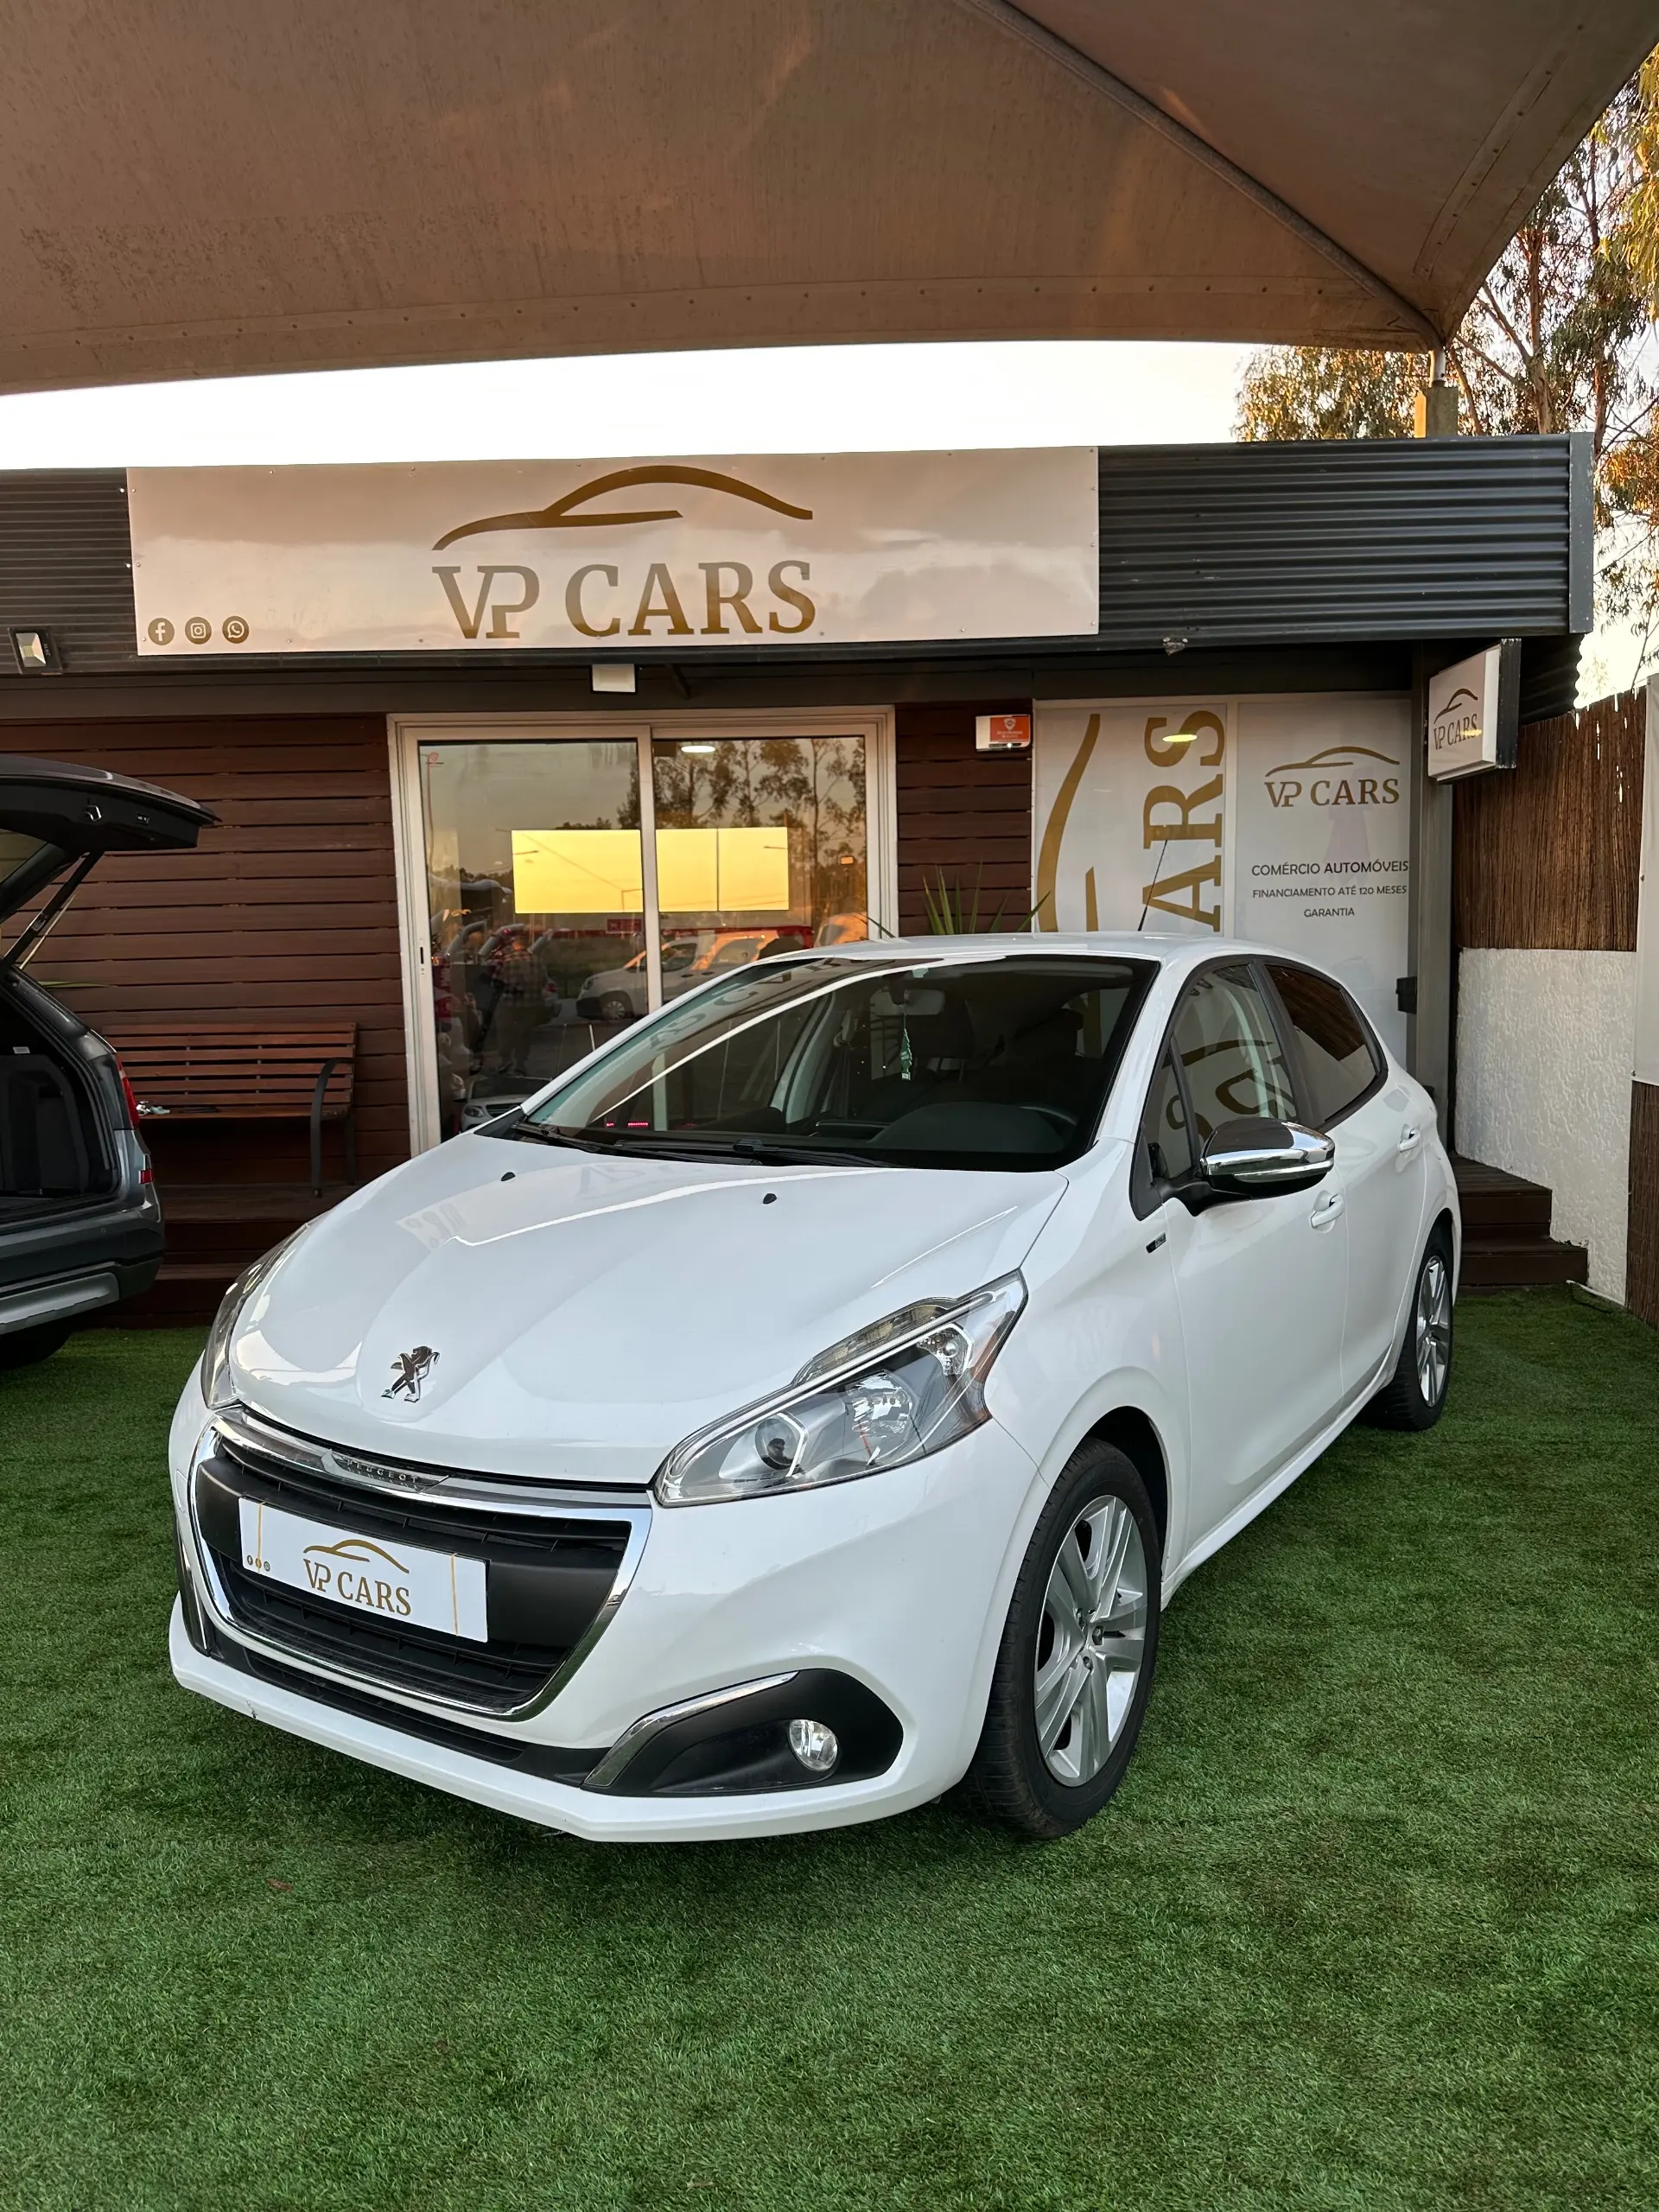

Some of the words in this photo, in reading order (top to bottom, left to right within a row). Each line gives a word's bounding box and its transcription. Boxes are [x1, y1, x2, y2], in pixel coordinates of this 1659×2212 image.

[432, 565, 540, 639] VP
[565, 560, 817, 638] CARS
[1433, 726, 1446, 750] VP
[1446, 713, 1478, 746] CARS
[1264, 781, 1302, 808] VP
[1310, 779, 1400, 806] CARS
[1141, 709, 1225, 932] ARS
[1251, 861, 1320, 876] COMÉRCIO
[1324, 859, 1409, 874] AUTOMÓVEIS
[1253, 887, 1336, 899] FINANCIAMENTO
[1338, 885, 1357, 896] ATÉ
[1359, 887, 1374, 895] 120
[1376, 885, 1407, 895] MESES
[1303, 907, 1355, 918] GARANTIA
[346, 1459, 418, 1484] PEUGEOT
[303, 1558, 332, 1592] VP
[337, 1571, 412, 1617] CARS
